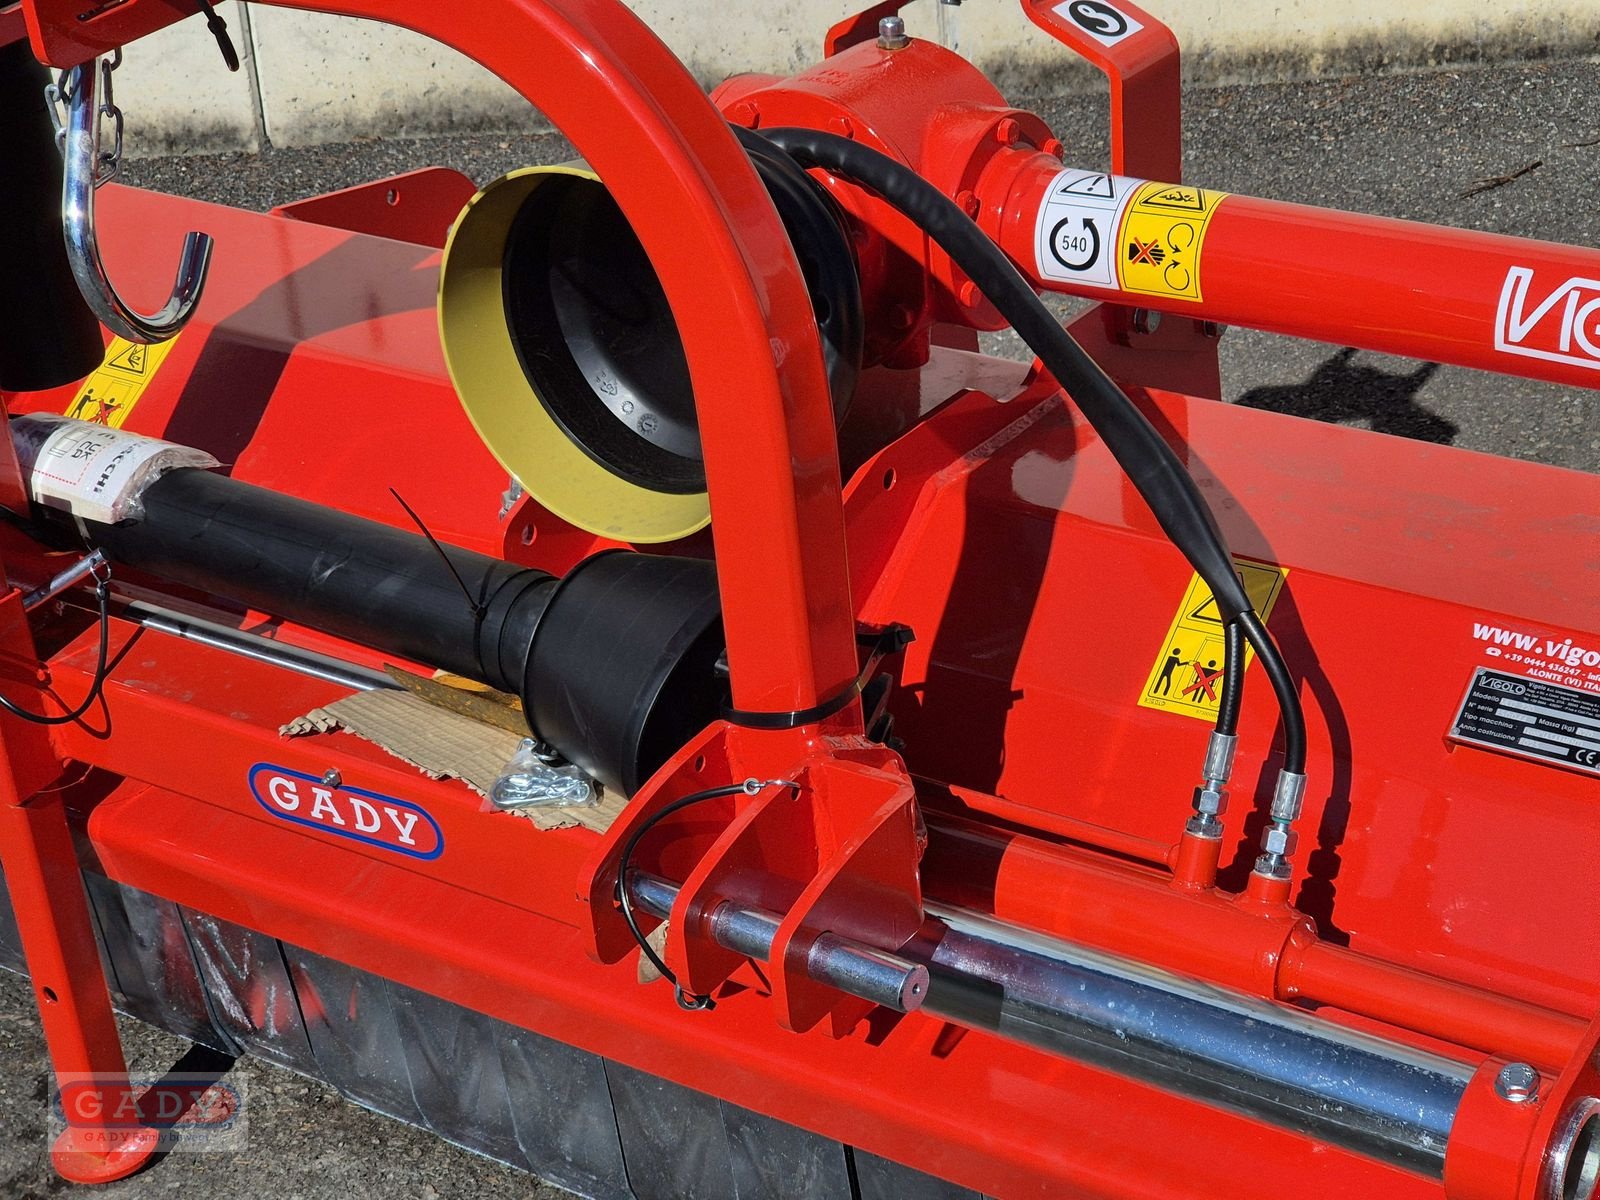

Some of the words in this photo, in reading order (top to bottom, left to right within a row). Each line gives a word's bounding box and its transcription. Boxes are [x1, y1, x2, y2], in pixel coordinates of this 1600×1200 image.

[1062, 235, 1087, 252] 540
[1473, 623, 1600, 668] www.vigo
[1504, 653, 1523, 662] +39
[1525, 657, 1546, 668] 0444
[1548, 663, 1581, 676] 436247
[1479, 675, 1527, 696] VIGOLO
[1526, 668, 1563, 682] ALONTE
[1564, 677, 1583, 688] (VI)
[1472, 691, 1500, 702] Modello
[1464, 712, 1478, 720] Tipo
[1479, 717, 1513, 729] macchina
[1538, 718, 1560, 728] Massa
[1561, 724, 1576, 733] (kg)
[1459, 723, 1477, 731] Anno
[1477, 728, 1516, 741] costruzione
[1575, 749, 1597, 764] CE
[269, 776, 418, 845] GADY
